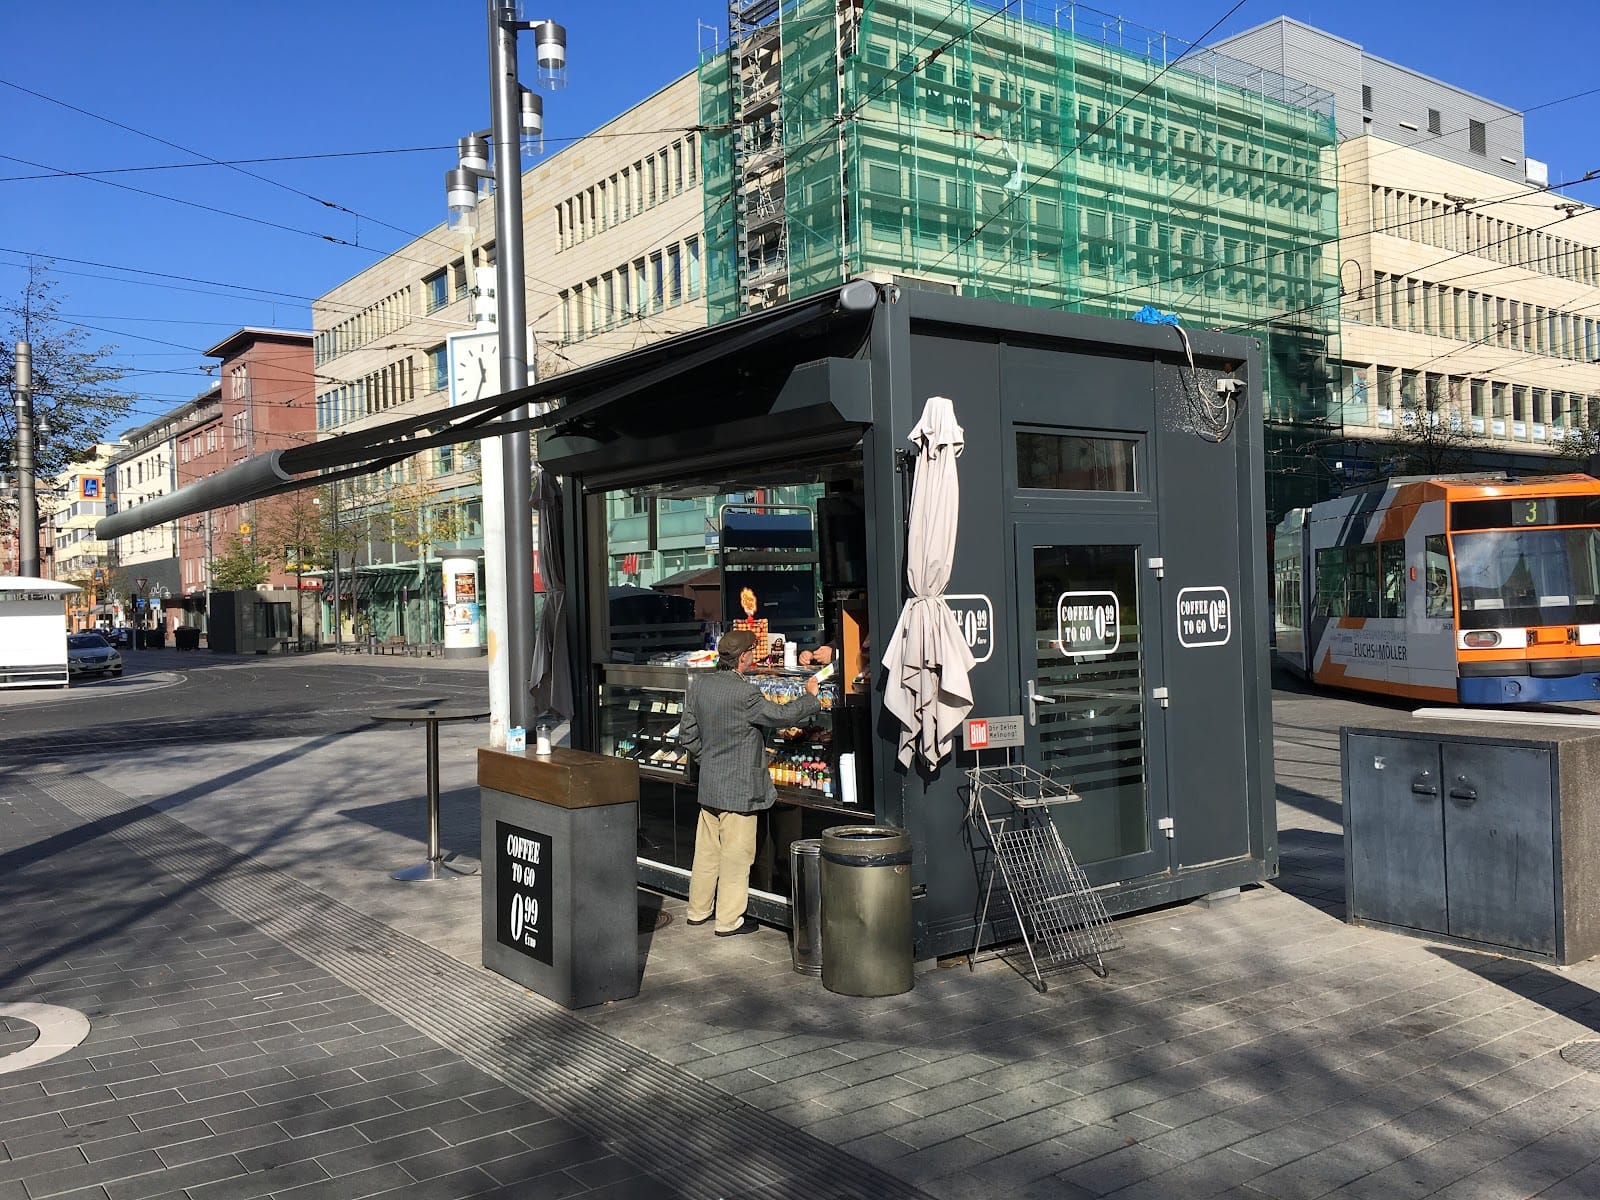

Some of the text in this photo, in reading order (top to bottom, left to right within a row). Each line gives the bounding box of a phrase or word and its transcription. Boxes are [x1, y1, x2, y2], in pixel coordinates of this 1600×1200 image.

[1525, 501, 1537, 523] 3
[1062, 605, 1094, 622] COFFEE
[1181, 600, 1209, 616] COFFEE
[1064, 625, 1092, 643] TO GO
[1183, 619, 1207, 635] TO GO
[971, 723, 987, 744] Bild
[507, 834, 541, 864] COFFEE
[512, 862, 536, 888] TO GO
